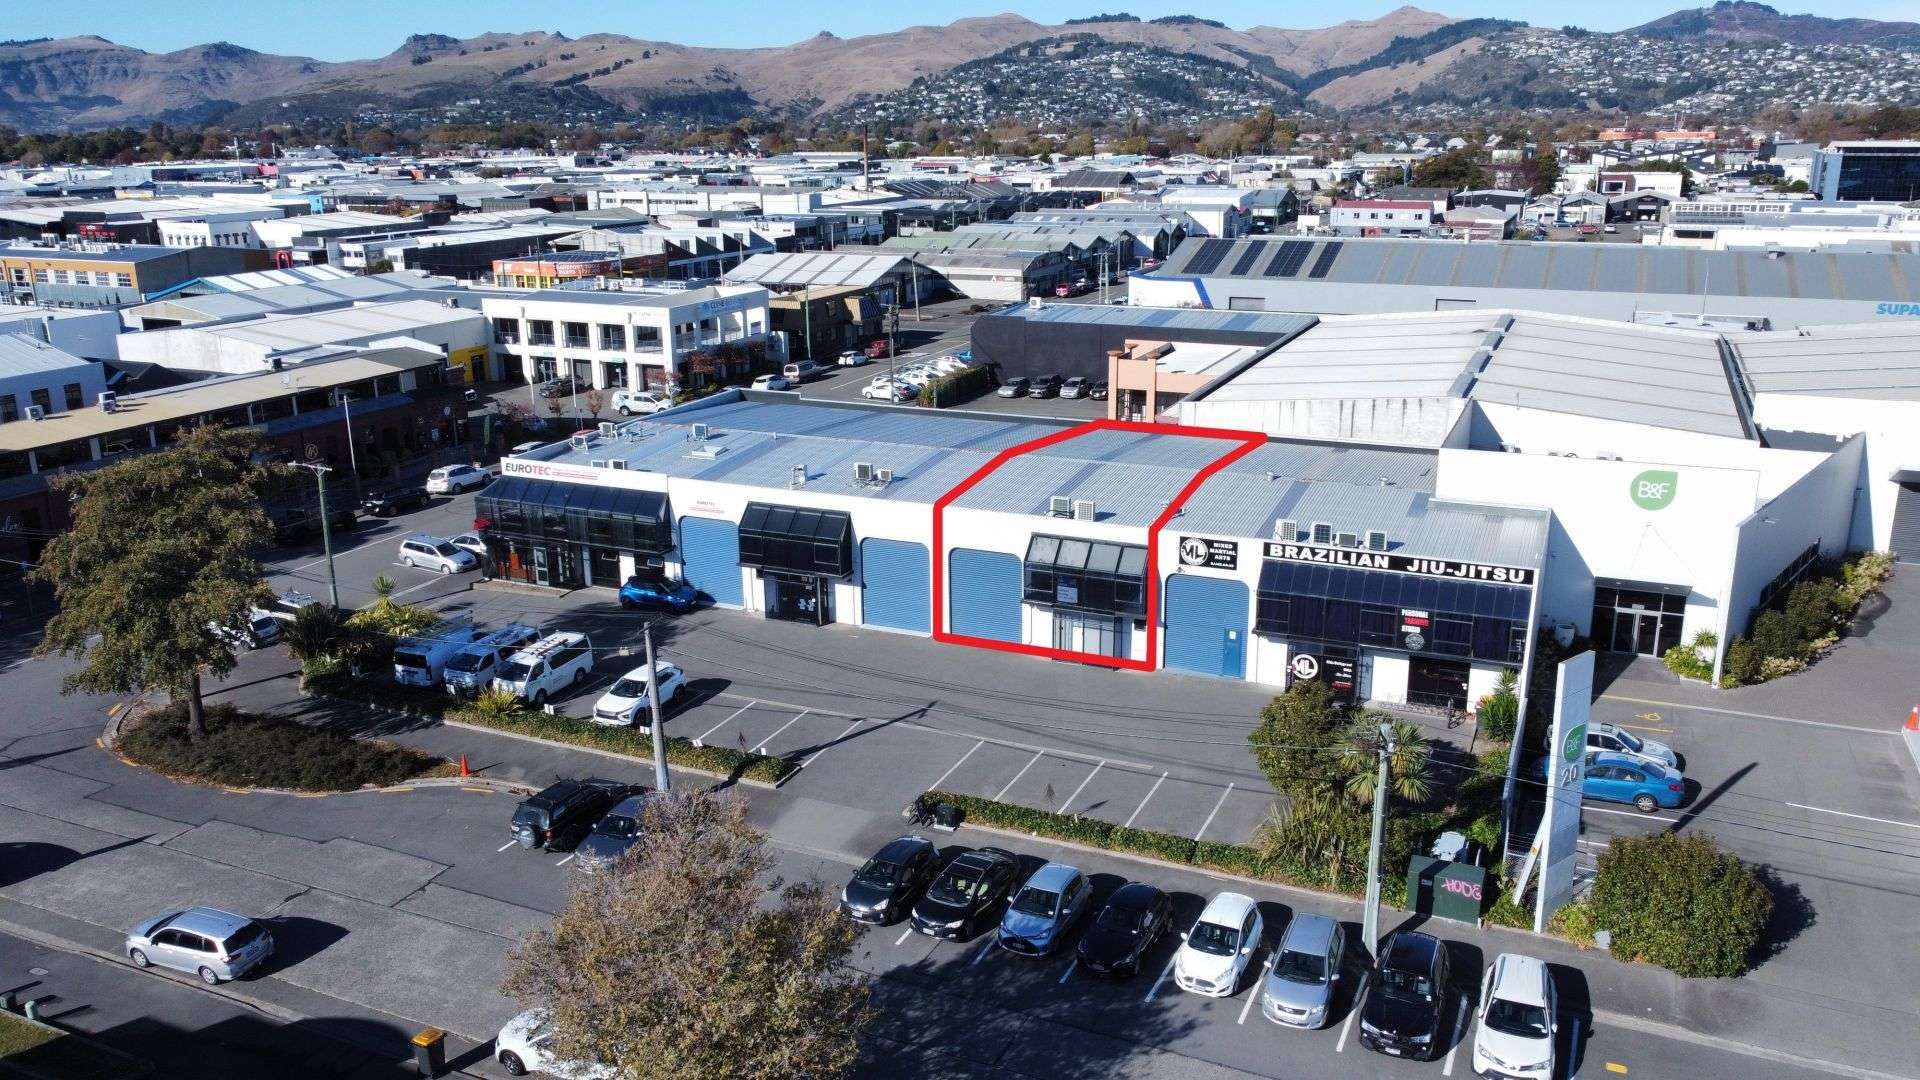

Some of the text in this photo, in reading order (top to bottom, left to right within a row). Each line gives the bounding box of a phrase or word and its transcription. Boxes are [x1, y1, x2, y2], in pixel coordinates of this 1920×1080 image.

[505, 462, 551, 476] EUROTEC
[1638, 480, 1670, 500] B&F
[1209, 548, 1237, 556] MARTIAL
[1269, 543, 1525, 583] BRAZILIAN JIU-JITSU
[1560, 765, 1578, 787] 20
